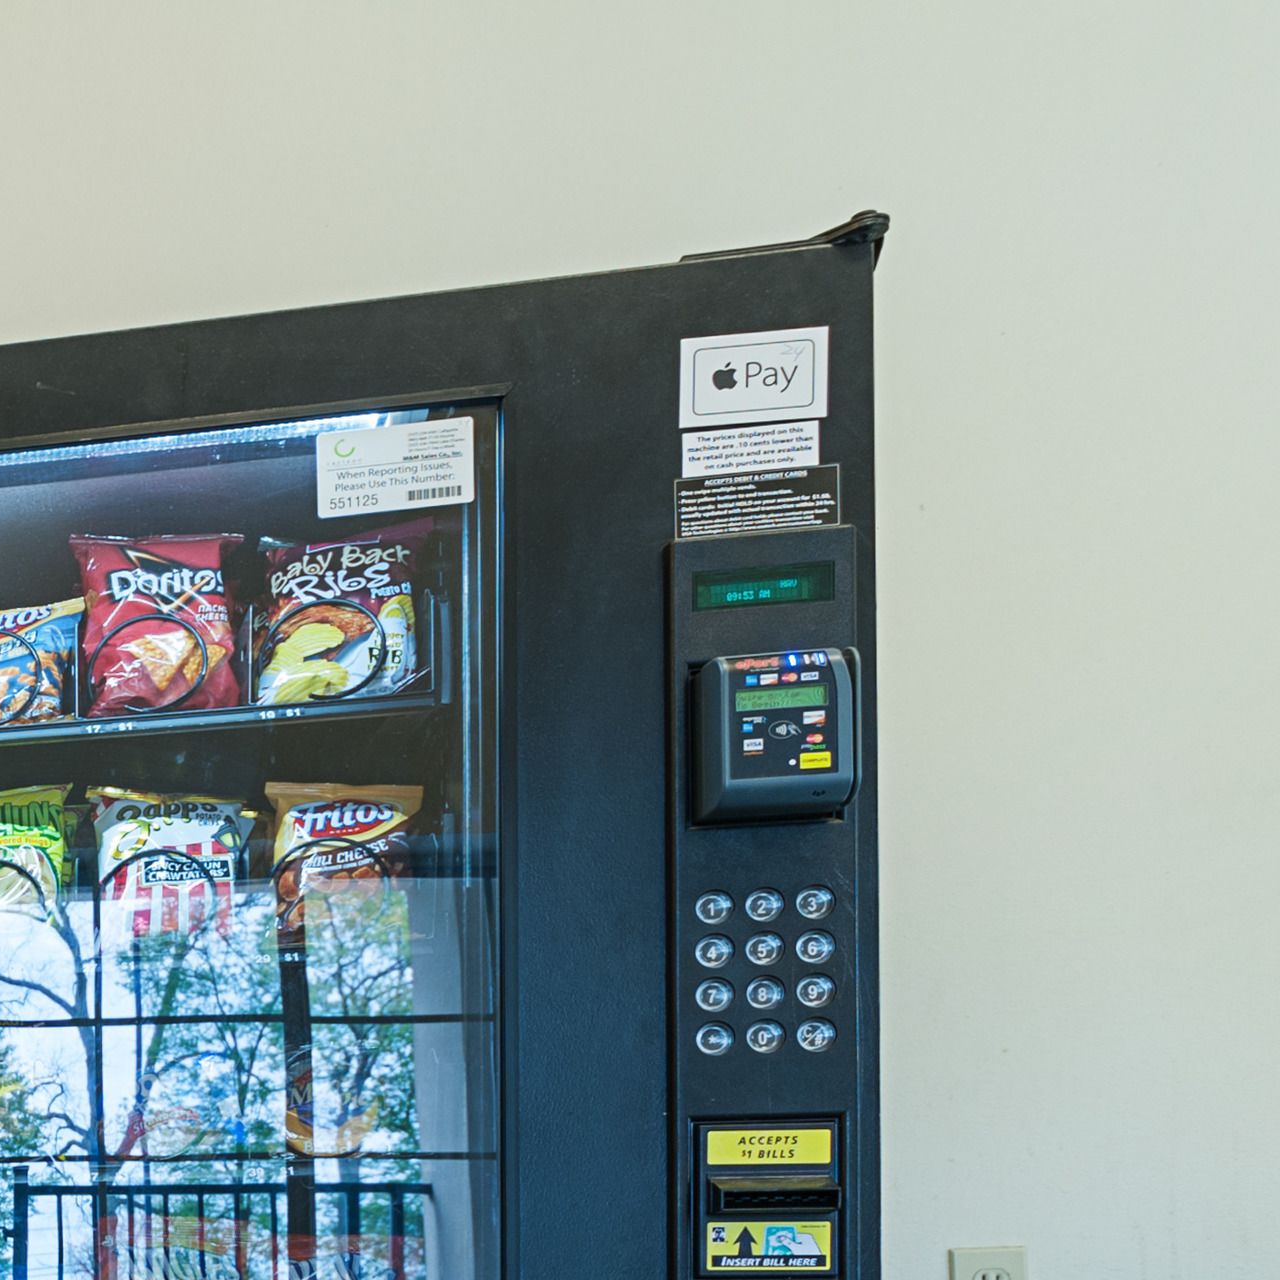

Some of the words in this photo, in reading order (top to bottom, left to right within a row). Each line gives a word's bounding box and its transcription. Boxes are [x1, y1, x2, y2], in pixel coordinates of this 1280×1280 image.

[745, 361, 798, 393] Pay
[687, 443, 720, 453] machine
[721, 443, 734, 451] are
[749, 439, 771, 448] cents
[772, 437, 794, 445] lower
[795, 434, 814, 443] than
[697, 435, 711, 443] The
[712, 433, 736, 443] prices
[737, 430, 776, 440] displayed
[688, 454, 701, 463] the
[702, 452, 723, 461] retail
[725, 450, 745, 460] price
[746, 449, 761, 458] and
[762, 447, 776, 455] are
[777, 444, 812, 454] available
[716, 461, 734, 469] cash
[735, 458, 775, 469] purchases
[777, 455, 796, 465] only.
[336, 470, 366, 480] When
[368, 462, 418, 478] Reporting
[334, 482, 366, 492] Please
[368, 479, 387, 489] Use
[390, 475, 409, 486] This
[411, 471, 456, 483] Number:
[329, 494, 379, 511] 551125
[270, 551, 333, 598] Baby
[341, 544, 411, 569] Back
[109, 567, 225, 601] Doritos
[282, 562, 391, 605] Ribs
[195, 812, 222, 821] POTATO
[290, 800, 394, 836] Fritos
[707, 902, 715, 916] 1
[757, 900, 766, 914] 2
[807, 897, 817, 911] 3
[706, 946, 717, 960] 4
[757, 944, 767, 957] 5
[807, 942, 817, 956] 6
[707, 990, 716, 1003] 7
[757, 987, 767, 1001] 8
[807, 985, 818, 999] 9
[757, 1031, 767, 1045] 0
[738, 1135, 799, 1146] ACCEPTS
[741, 1149, 752, 1159] $1
[758, 1148, 796, 1159] BILLS
[721, 1256, 762, 1268] INSERT
[763, 1256, 787, 1268] BILL
[789, 1256, 818, 1267] HERE
